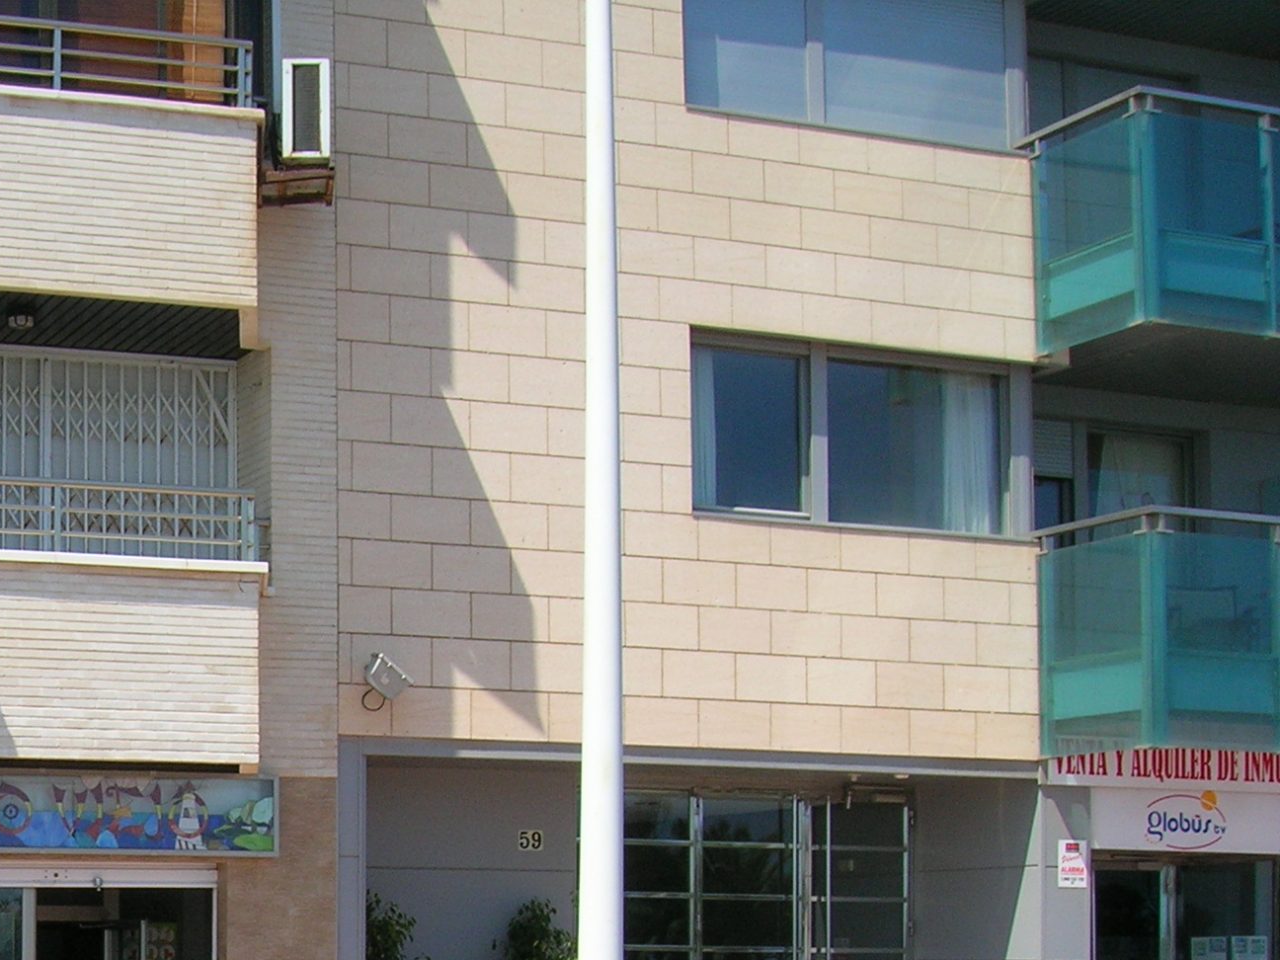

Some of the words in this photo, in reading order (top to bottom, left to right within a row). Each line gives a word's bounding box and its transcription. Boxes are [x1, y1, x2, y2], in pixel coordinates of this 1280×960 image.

[1115, 749, 1124, 777] Y
[1131, 748, 1211, 782] ALQUILER
[1217, 750, 1239, 782] DE
[519, 831, 542, 850] 59
